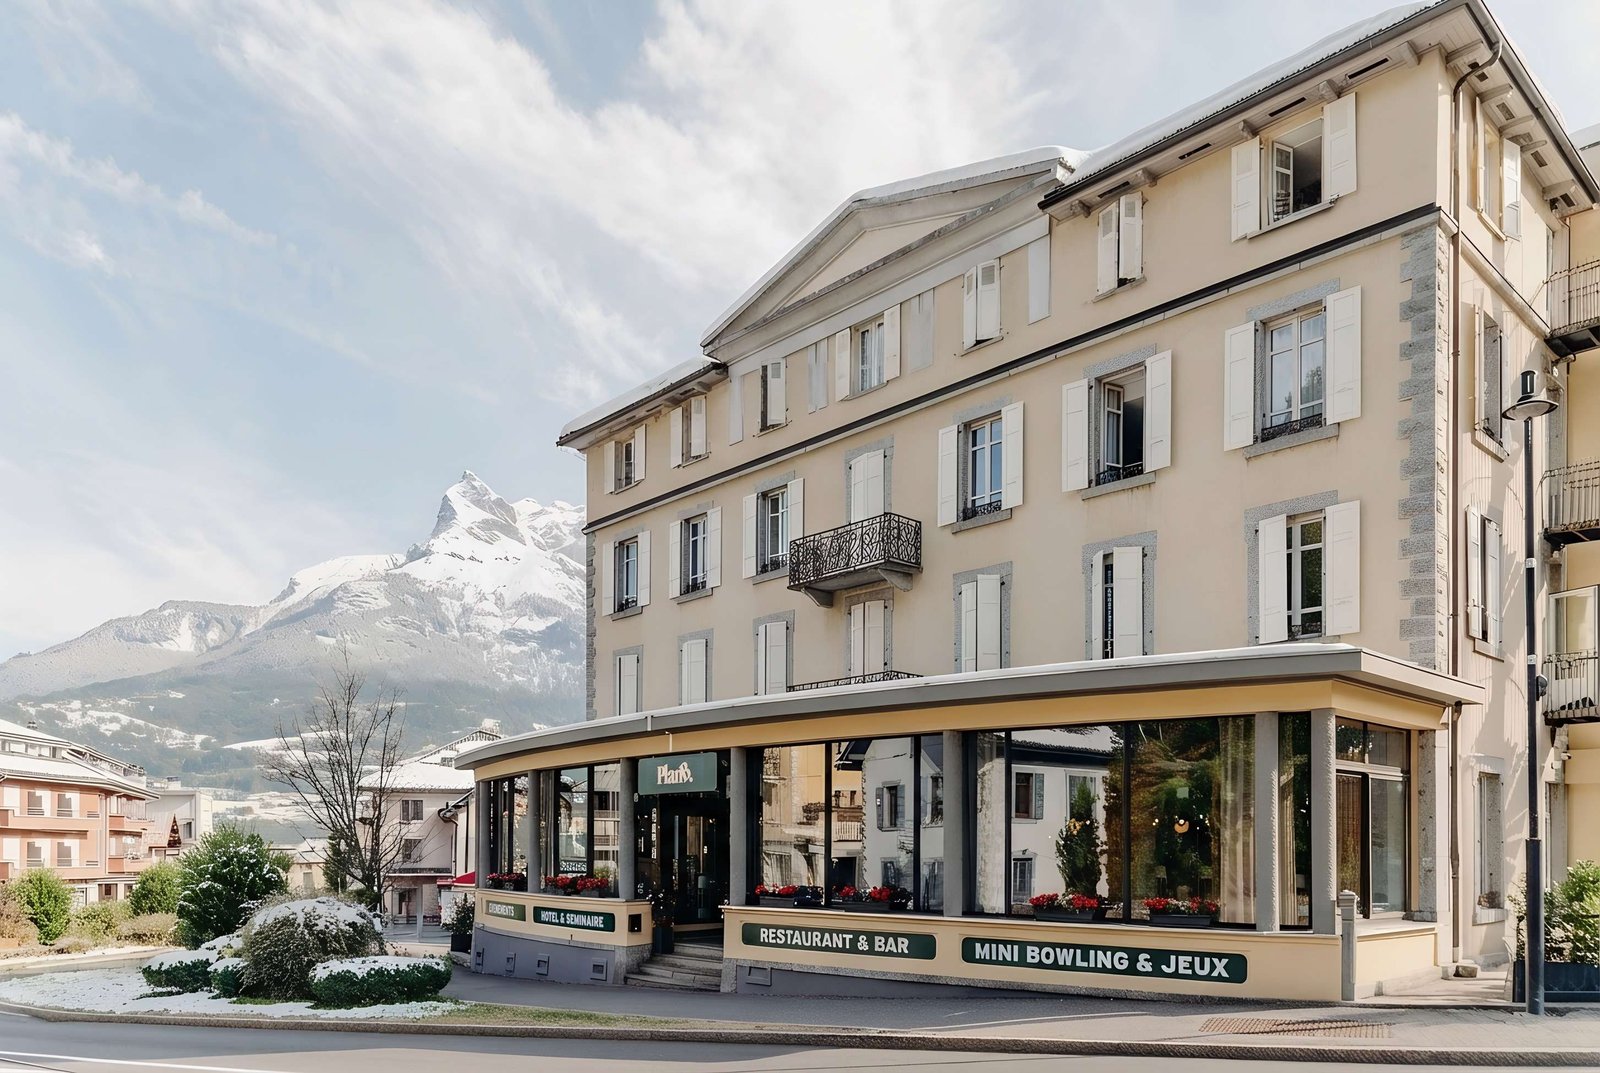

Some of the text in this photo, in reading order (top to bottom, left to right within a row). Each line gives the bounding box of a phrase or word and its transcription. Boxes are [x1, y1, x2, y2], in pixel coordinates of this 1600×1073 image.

[541, 911, 604, 927] HOTEL & SEMINAIRE
[760, 928, 909, 953] RESTAURANT & BAR
[975, 943, 1229, 977] MINI BOWLING & JEUX
